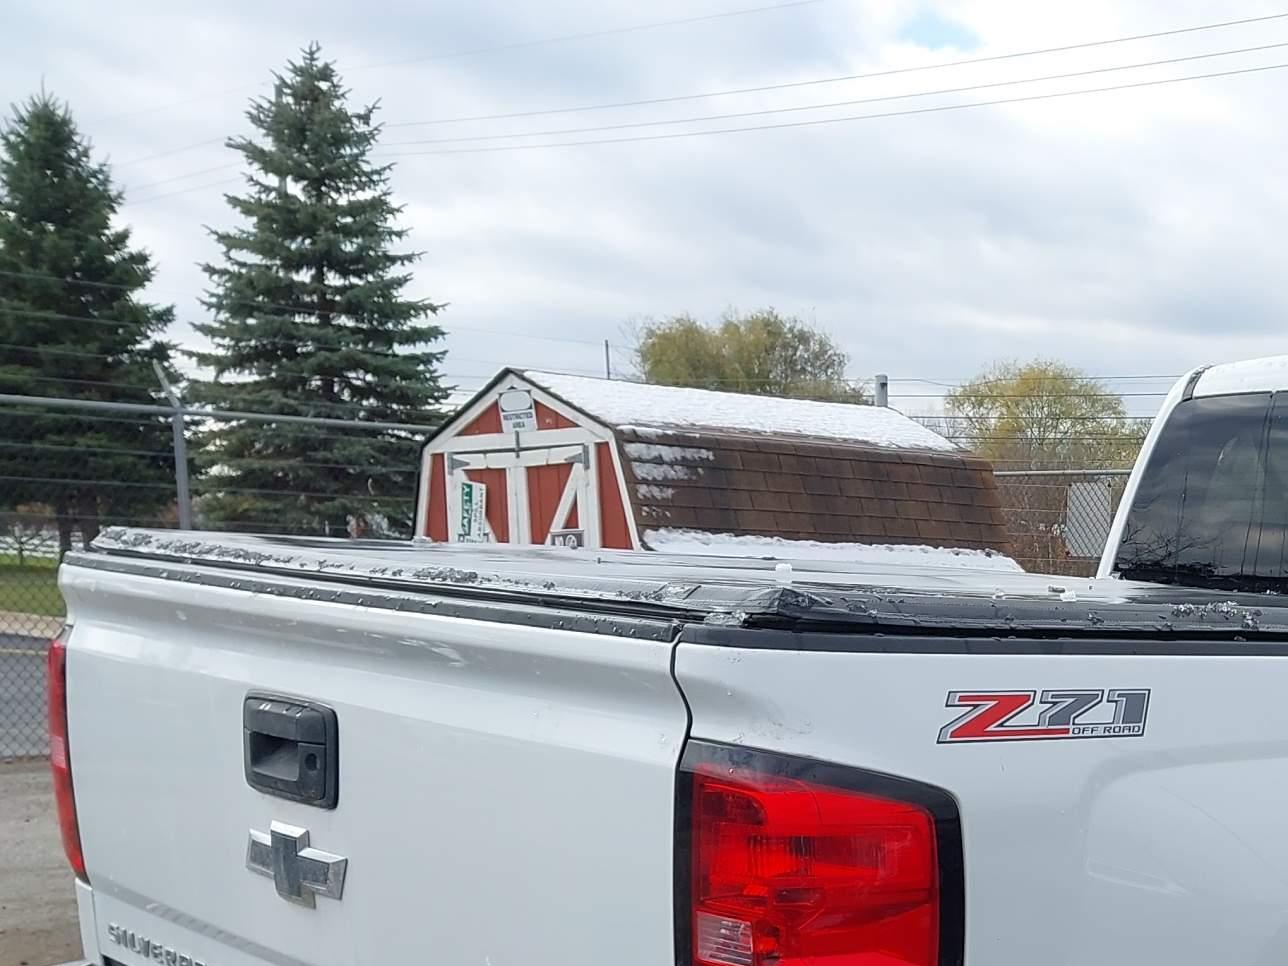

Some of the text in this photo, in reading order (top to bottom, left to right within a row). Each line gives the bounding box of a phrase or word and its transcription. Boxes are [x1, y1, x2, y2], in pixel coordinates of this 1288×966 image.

[937, 689, 1151, 744] Z71
[1071, 725, 1141, 735] OFF ROAD
